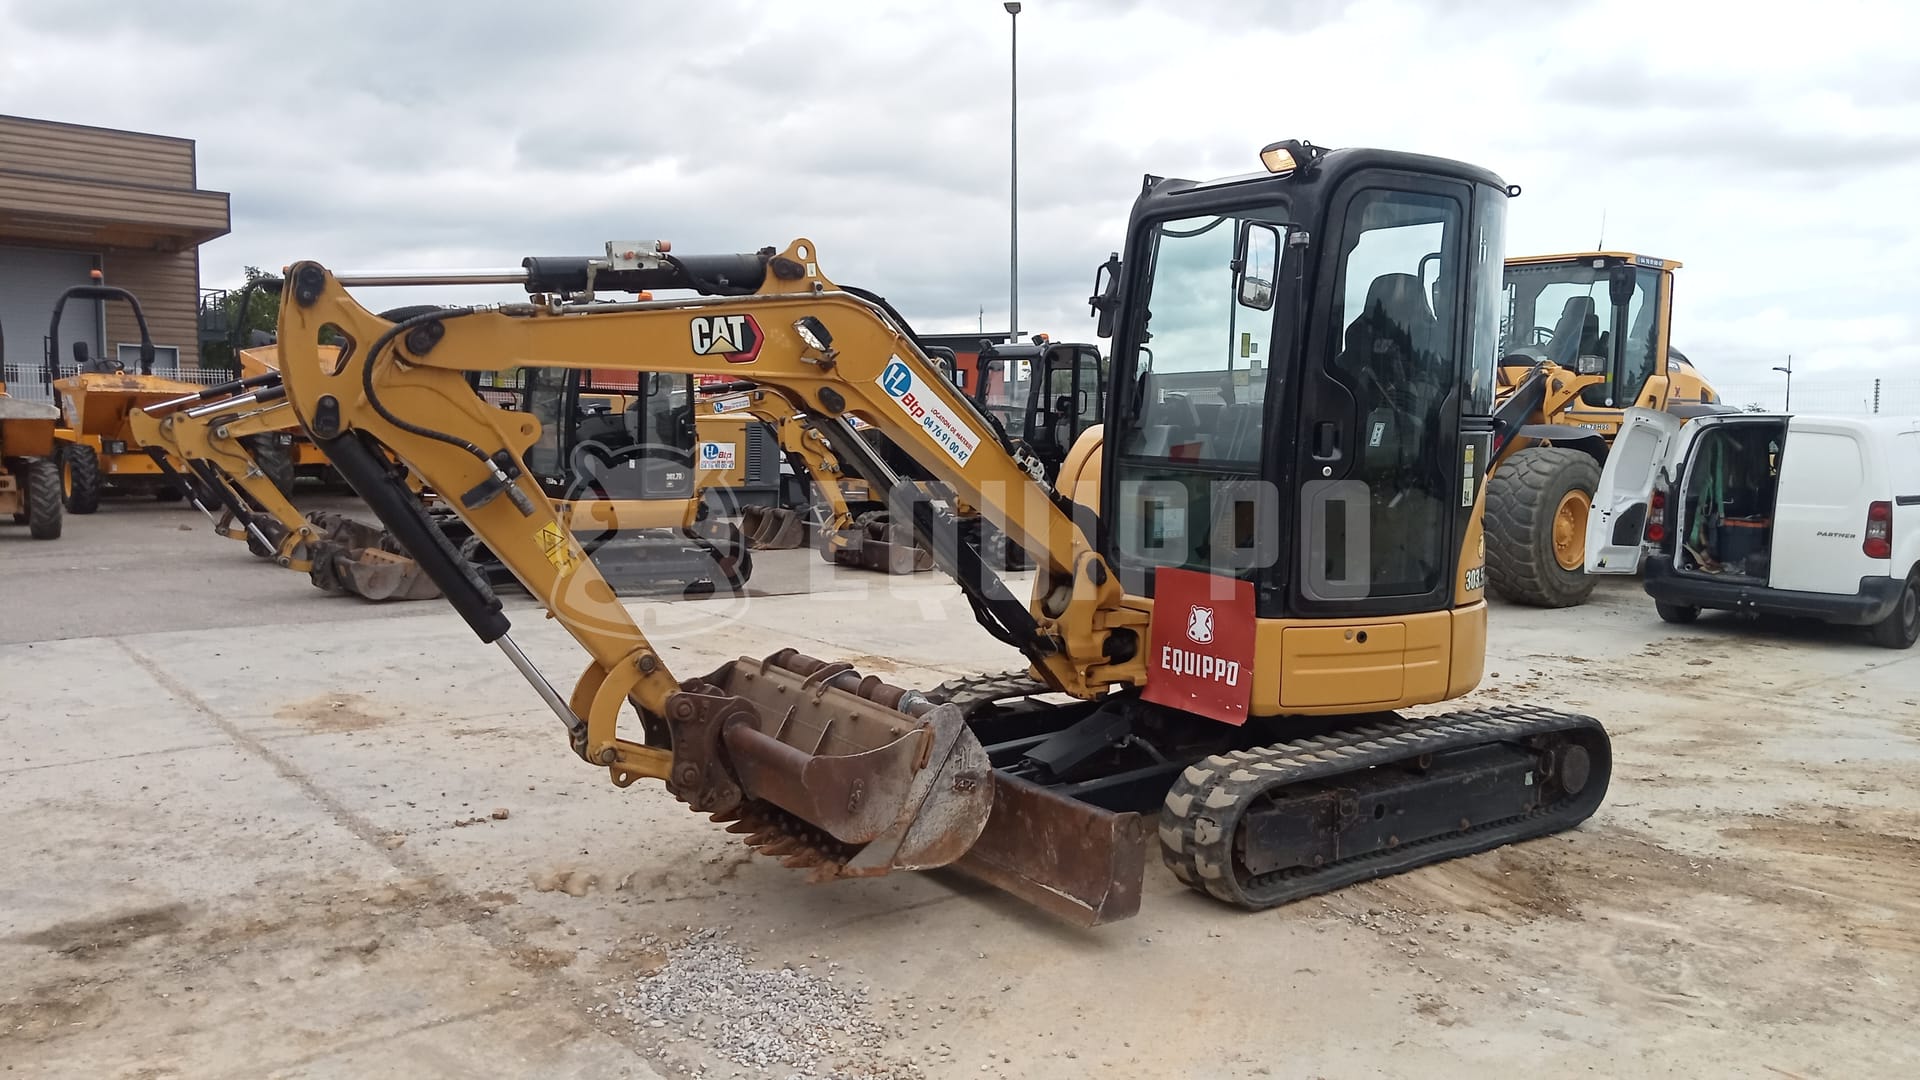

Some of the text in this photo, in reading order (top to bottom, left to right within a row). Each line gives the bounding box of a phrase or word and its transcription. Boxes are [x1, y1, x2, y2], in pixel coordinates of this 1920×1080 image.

[691, 315, 745, 355] CAT
[901, 392, 926, 418] Btp
[930, 407, 954, 431] LOCATION
[923, 416, 969, 462] 04 76 91 00 47
[1816, 531, 1856, 539] PARTNER
[1161, 645, 1240, 687] EQUIPPO
